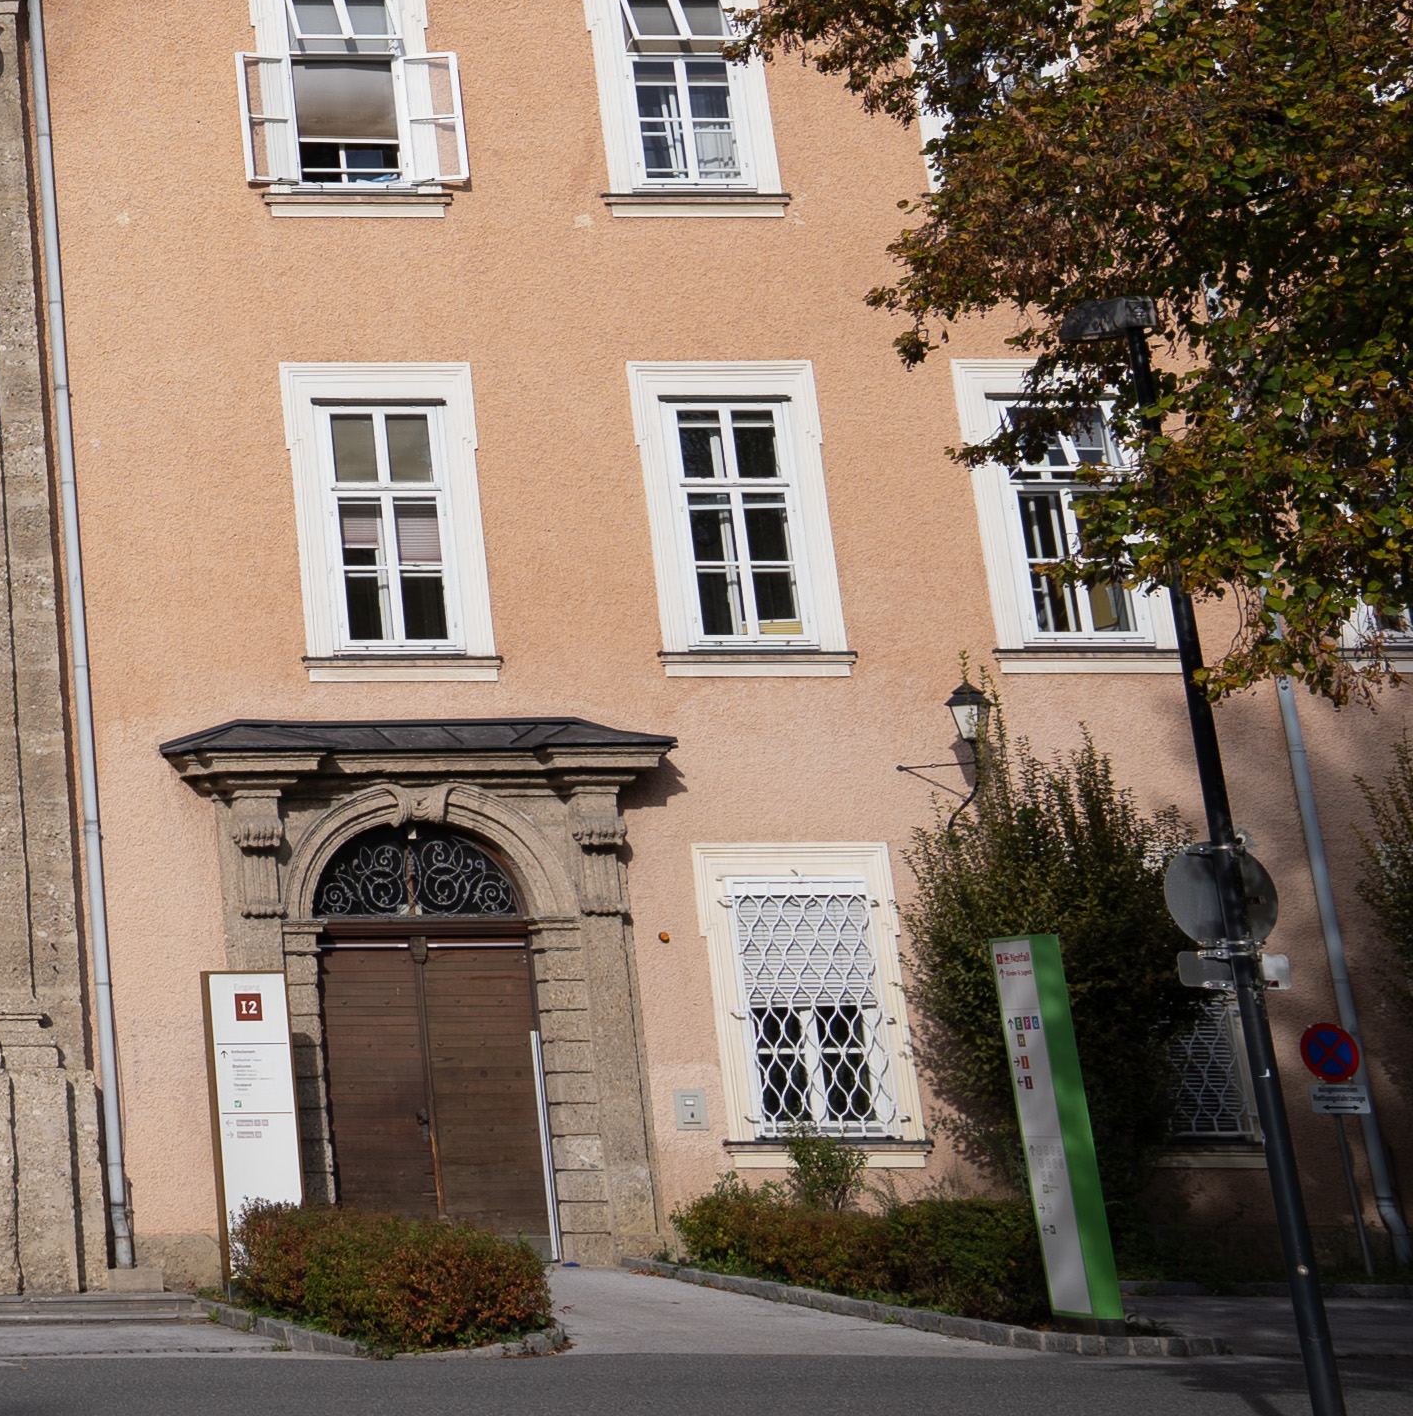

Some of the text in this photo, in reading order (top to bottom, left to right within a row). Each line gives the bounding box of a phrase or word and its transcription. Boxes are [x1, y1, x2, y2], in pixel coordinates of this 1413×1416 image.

[1010, 952, 1030, 962] Notfall
[233, 983, 261, 992] Eingang
[240, 1000, 258, 1014] I2
